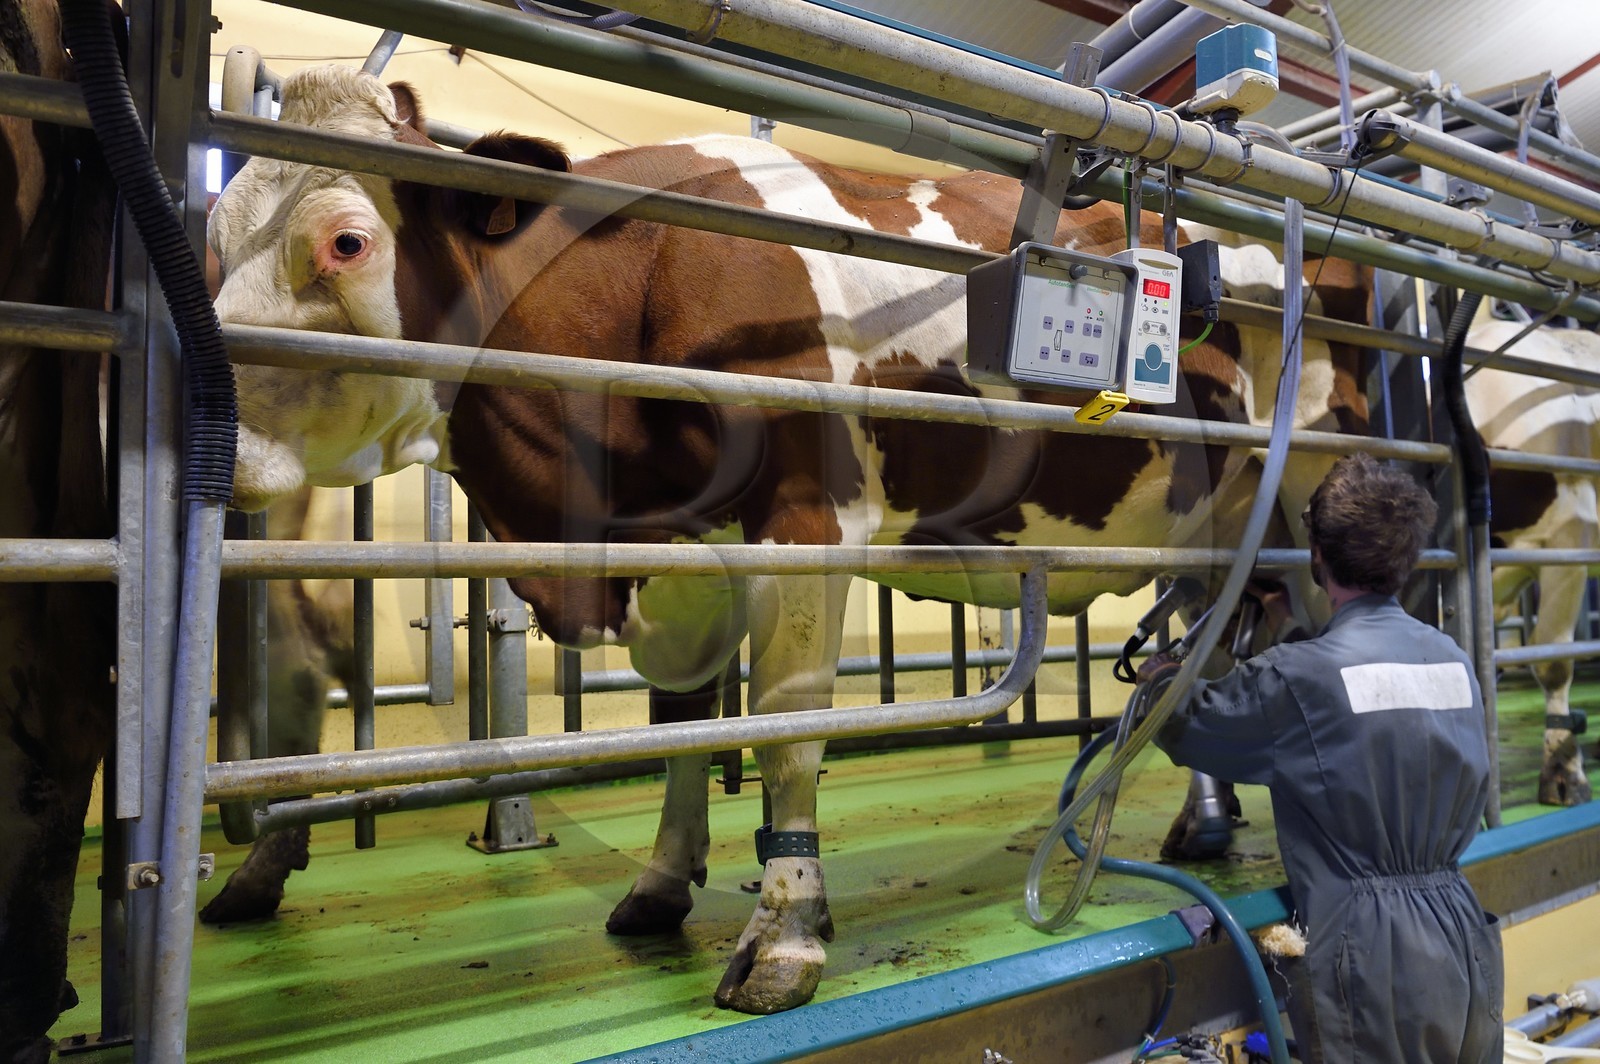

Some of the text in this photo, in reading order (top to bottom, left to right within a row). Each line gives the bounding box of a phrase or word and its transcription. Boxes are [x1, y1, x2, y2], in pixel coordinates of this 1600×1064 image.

[1162, 270, 1174, 278] GEA
[1148, 282, 1166, 297] 0.00
[1088, 403, 1116, 421] 2
